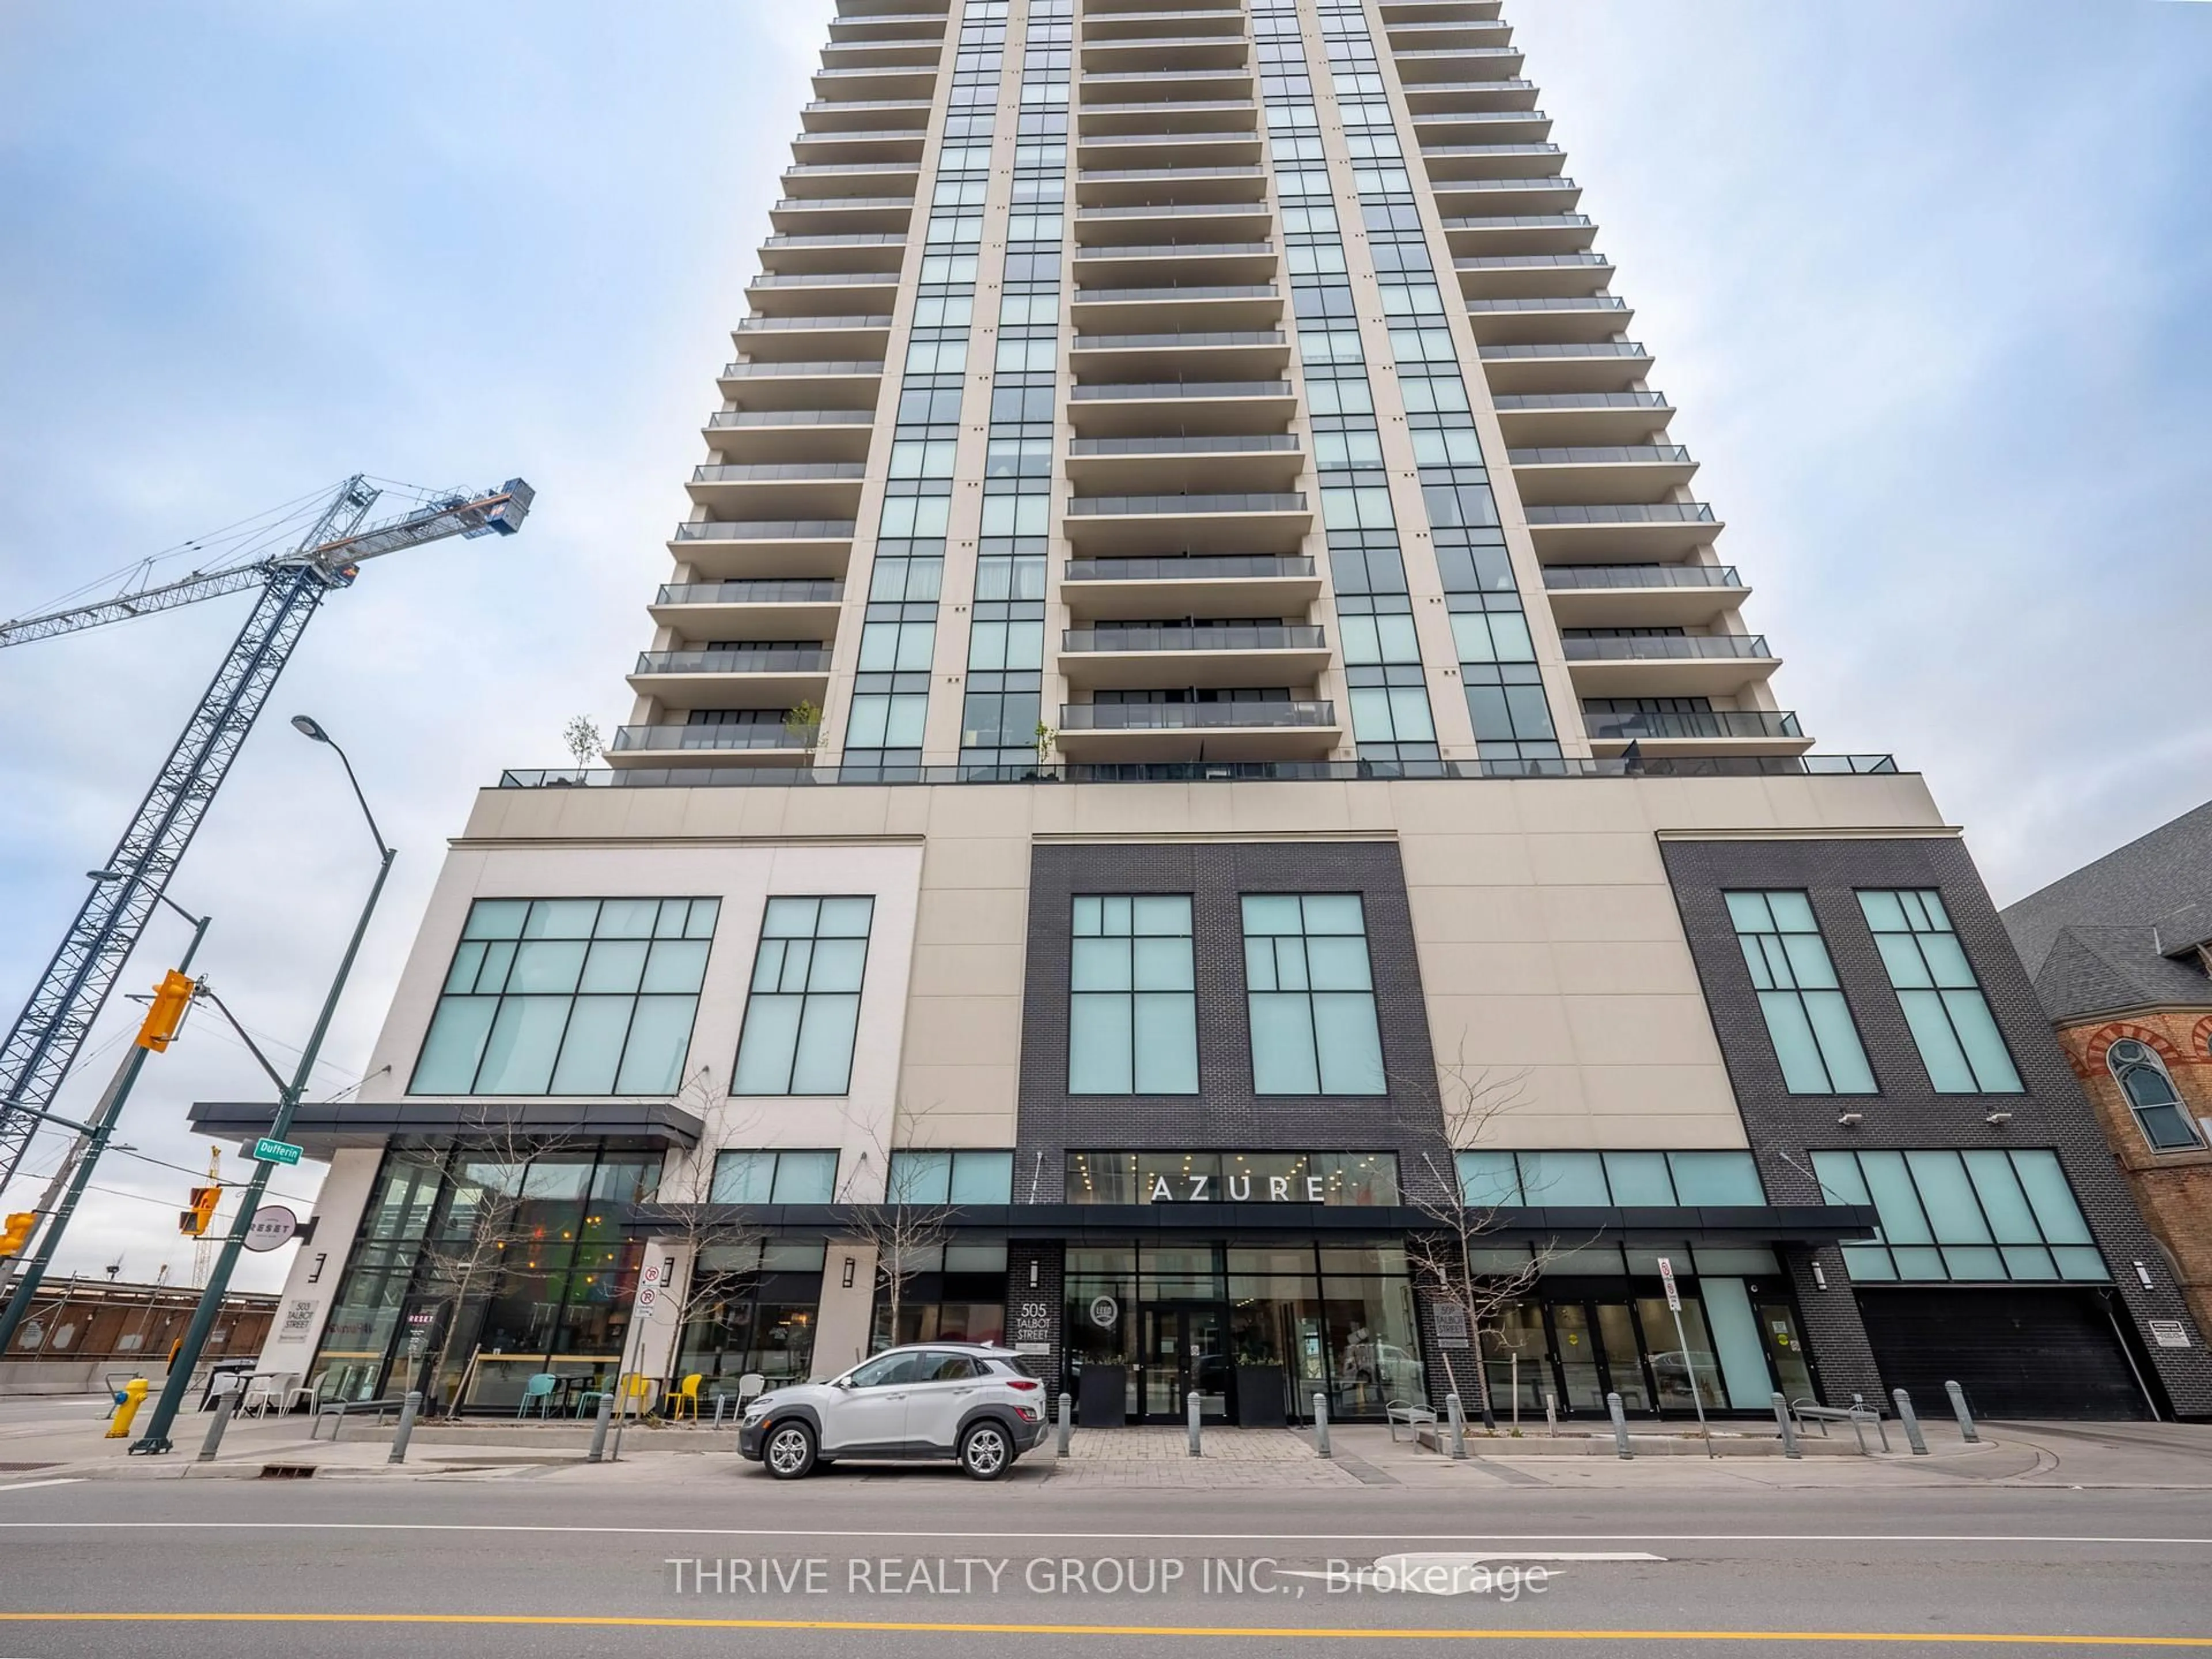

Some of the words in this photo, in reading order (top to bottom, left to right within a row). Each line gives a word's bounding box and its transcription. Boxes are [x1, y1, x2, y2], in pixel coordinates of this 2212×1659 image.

[260, 1142, 298, 1158] Dufferin
[1152, 1176, 1325, 1201] AZURE
[287, 1310, 314, 1320] TALBOT
[1021, 1304, 1047, 1317] 505
[285, 1320, 309, 1328] STREET
[1016, 1318, 1051, 1328] TALBOT
[1436, 1316, 1464, 1325] TALBOT
[1438, 1324, 1464, 1334] STREET
[1017, 1330, 1048, 1340] STREET
